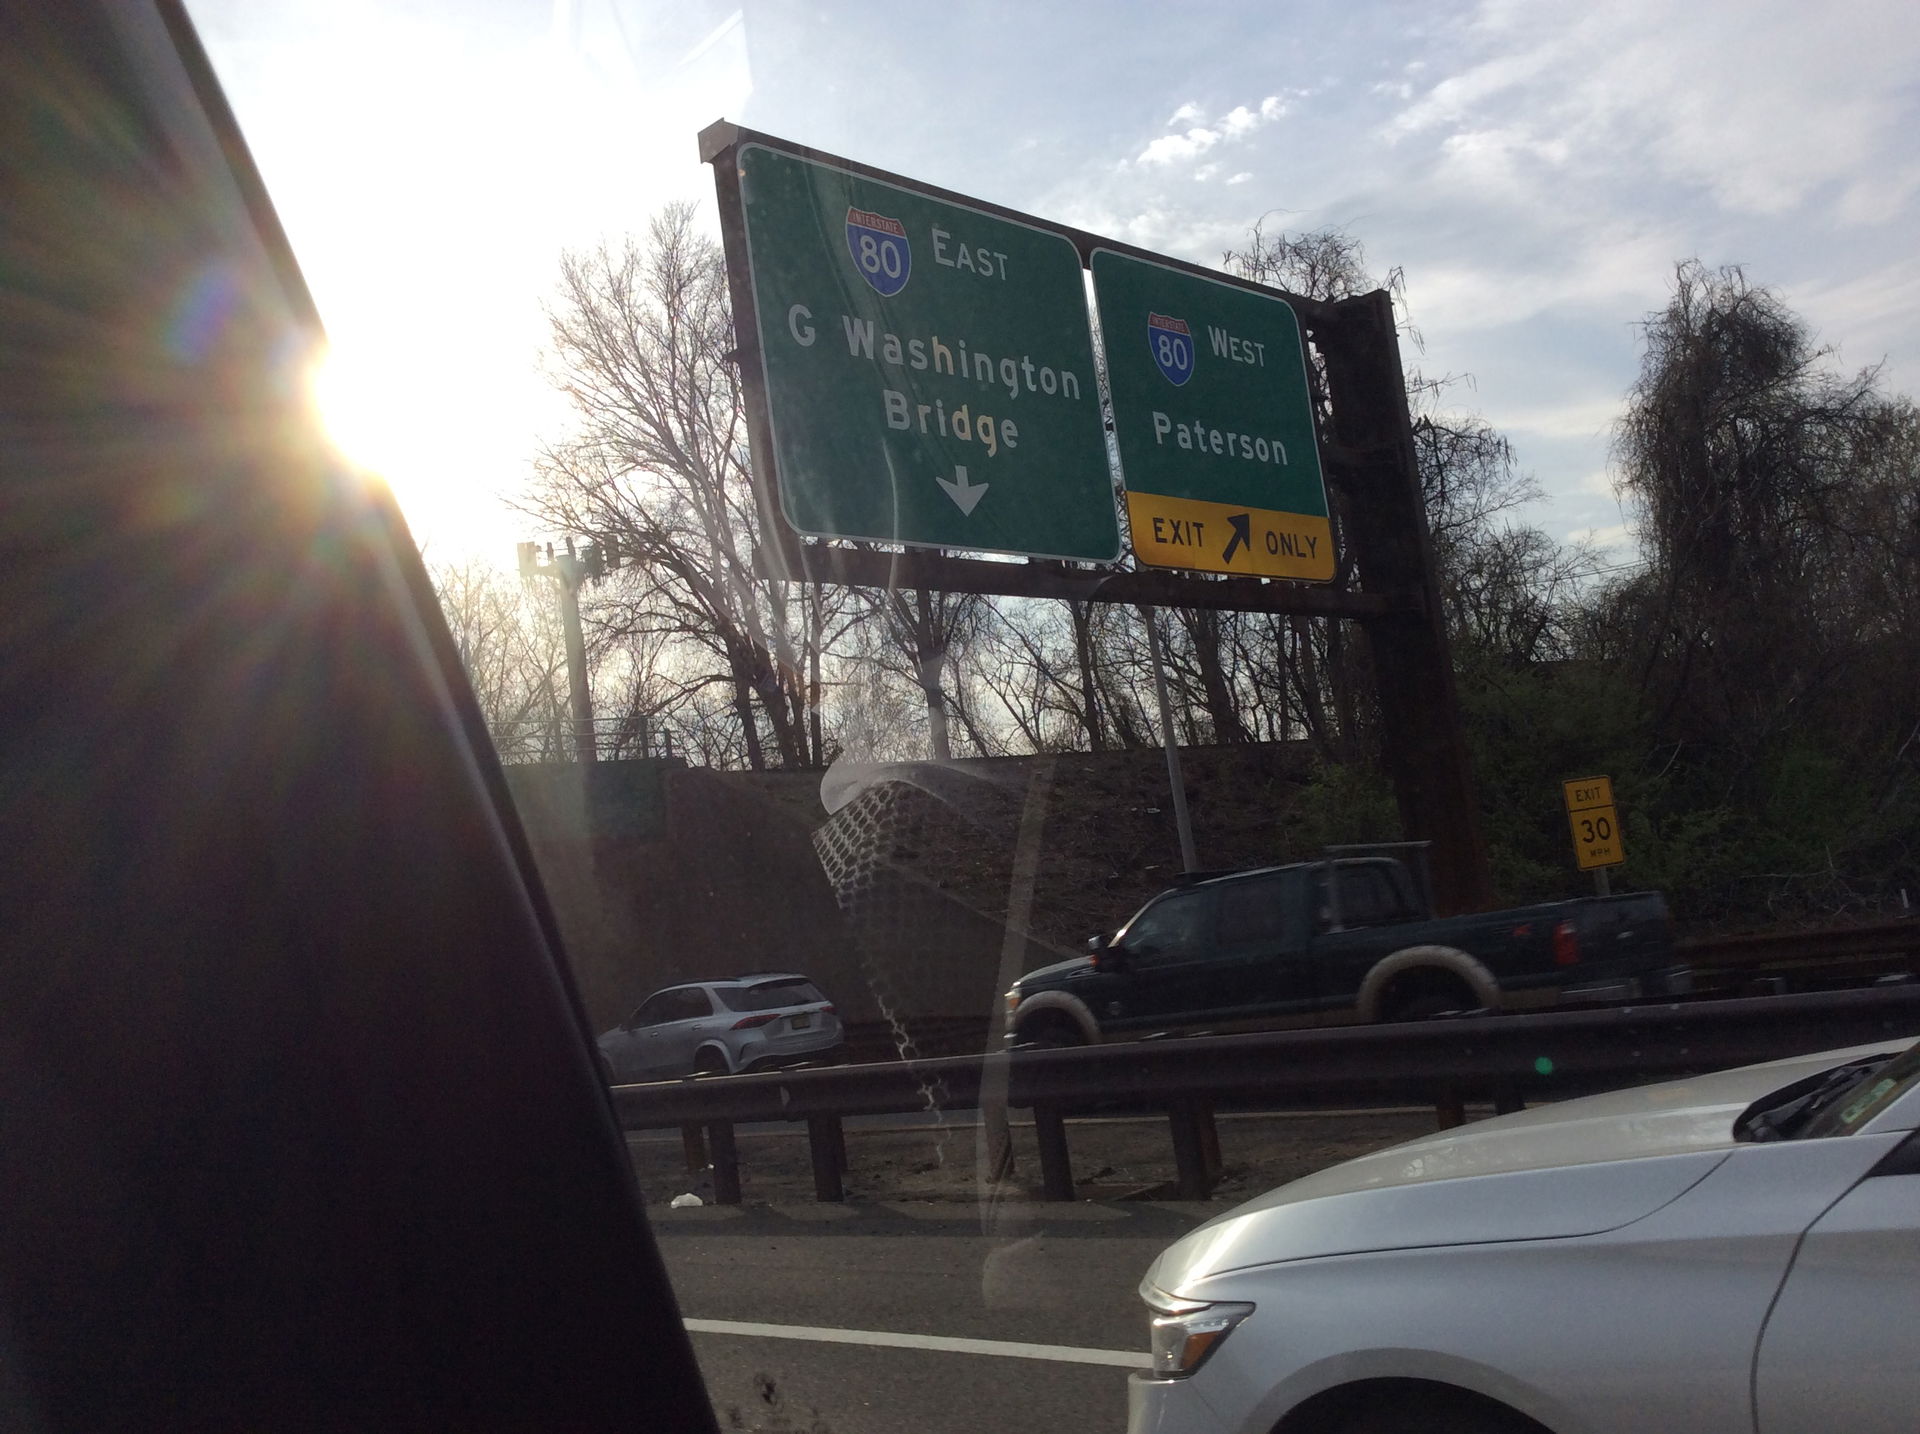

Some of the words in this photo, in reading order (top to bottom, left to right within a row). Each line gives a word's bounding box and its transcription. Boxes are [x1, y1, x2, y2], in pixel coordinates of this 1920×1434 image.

[852, 211, 899, 235] INTERSTATE
[860, 235, 901, 279] 80
[931, 227, 1008, 281] EAST
[1151, 316, 1186, 332] INTERSTATE
[788, 304, 816, 347] G
[842, 315, 1081, 400] Washington
[1158, 334, 1187, 370] 80
[1208, 325, 1265, 367] WEST
[883, 389, 1019, 458] Bridge
[1152, 411, 1288, 465] Paterson
[1152, 517, 1204, 547] EXIT
[1265, 530, 1318, 559] ONLY
[1575, 786, 1601, 802] EXIT
[1581, 817, 1611, 843] 30
